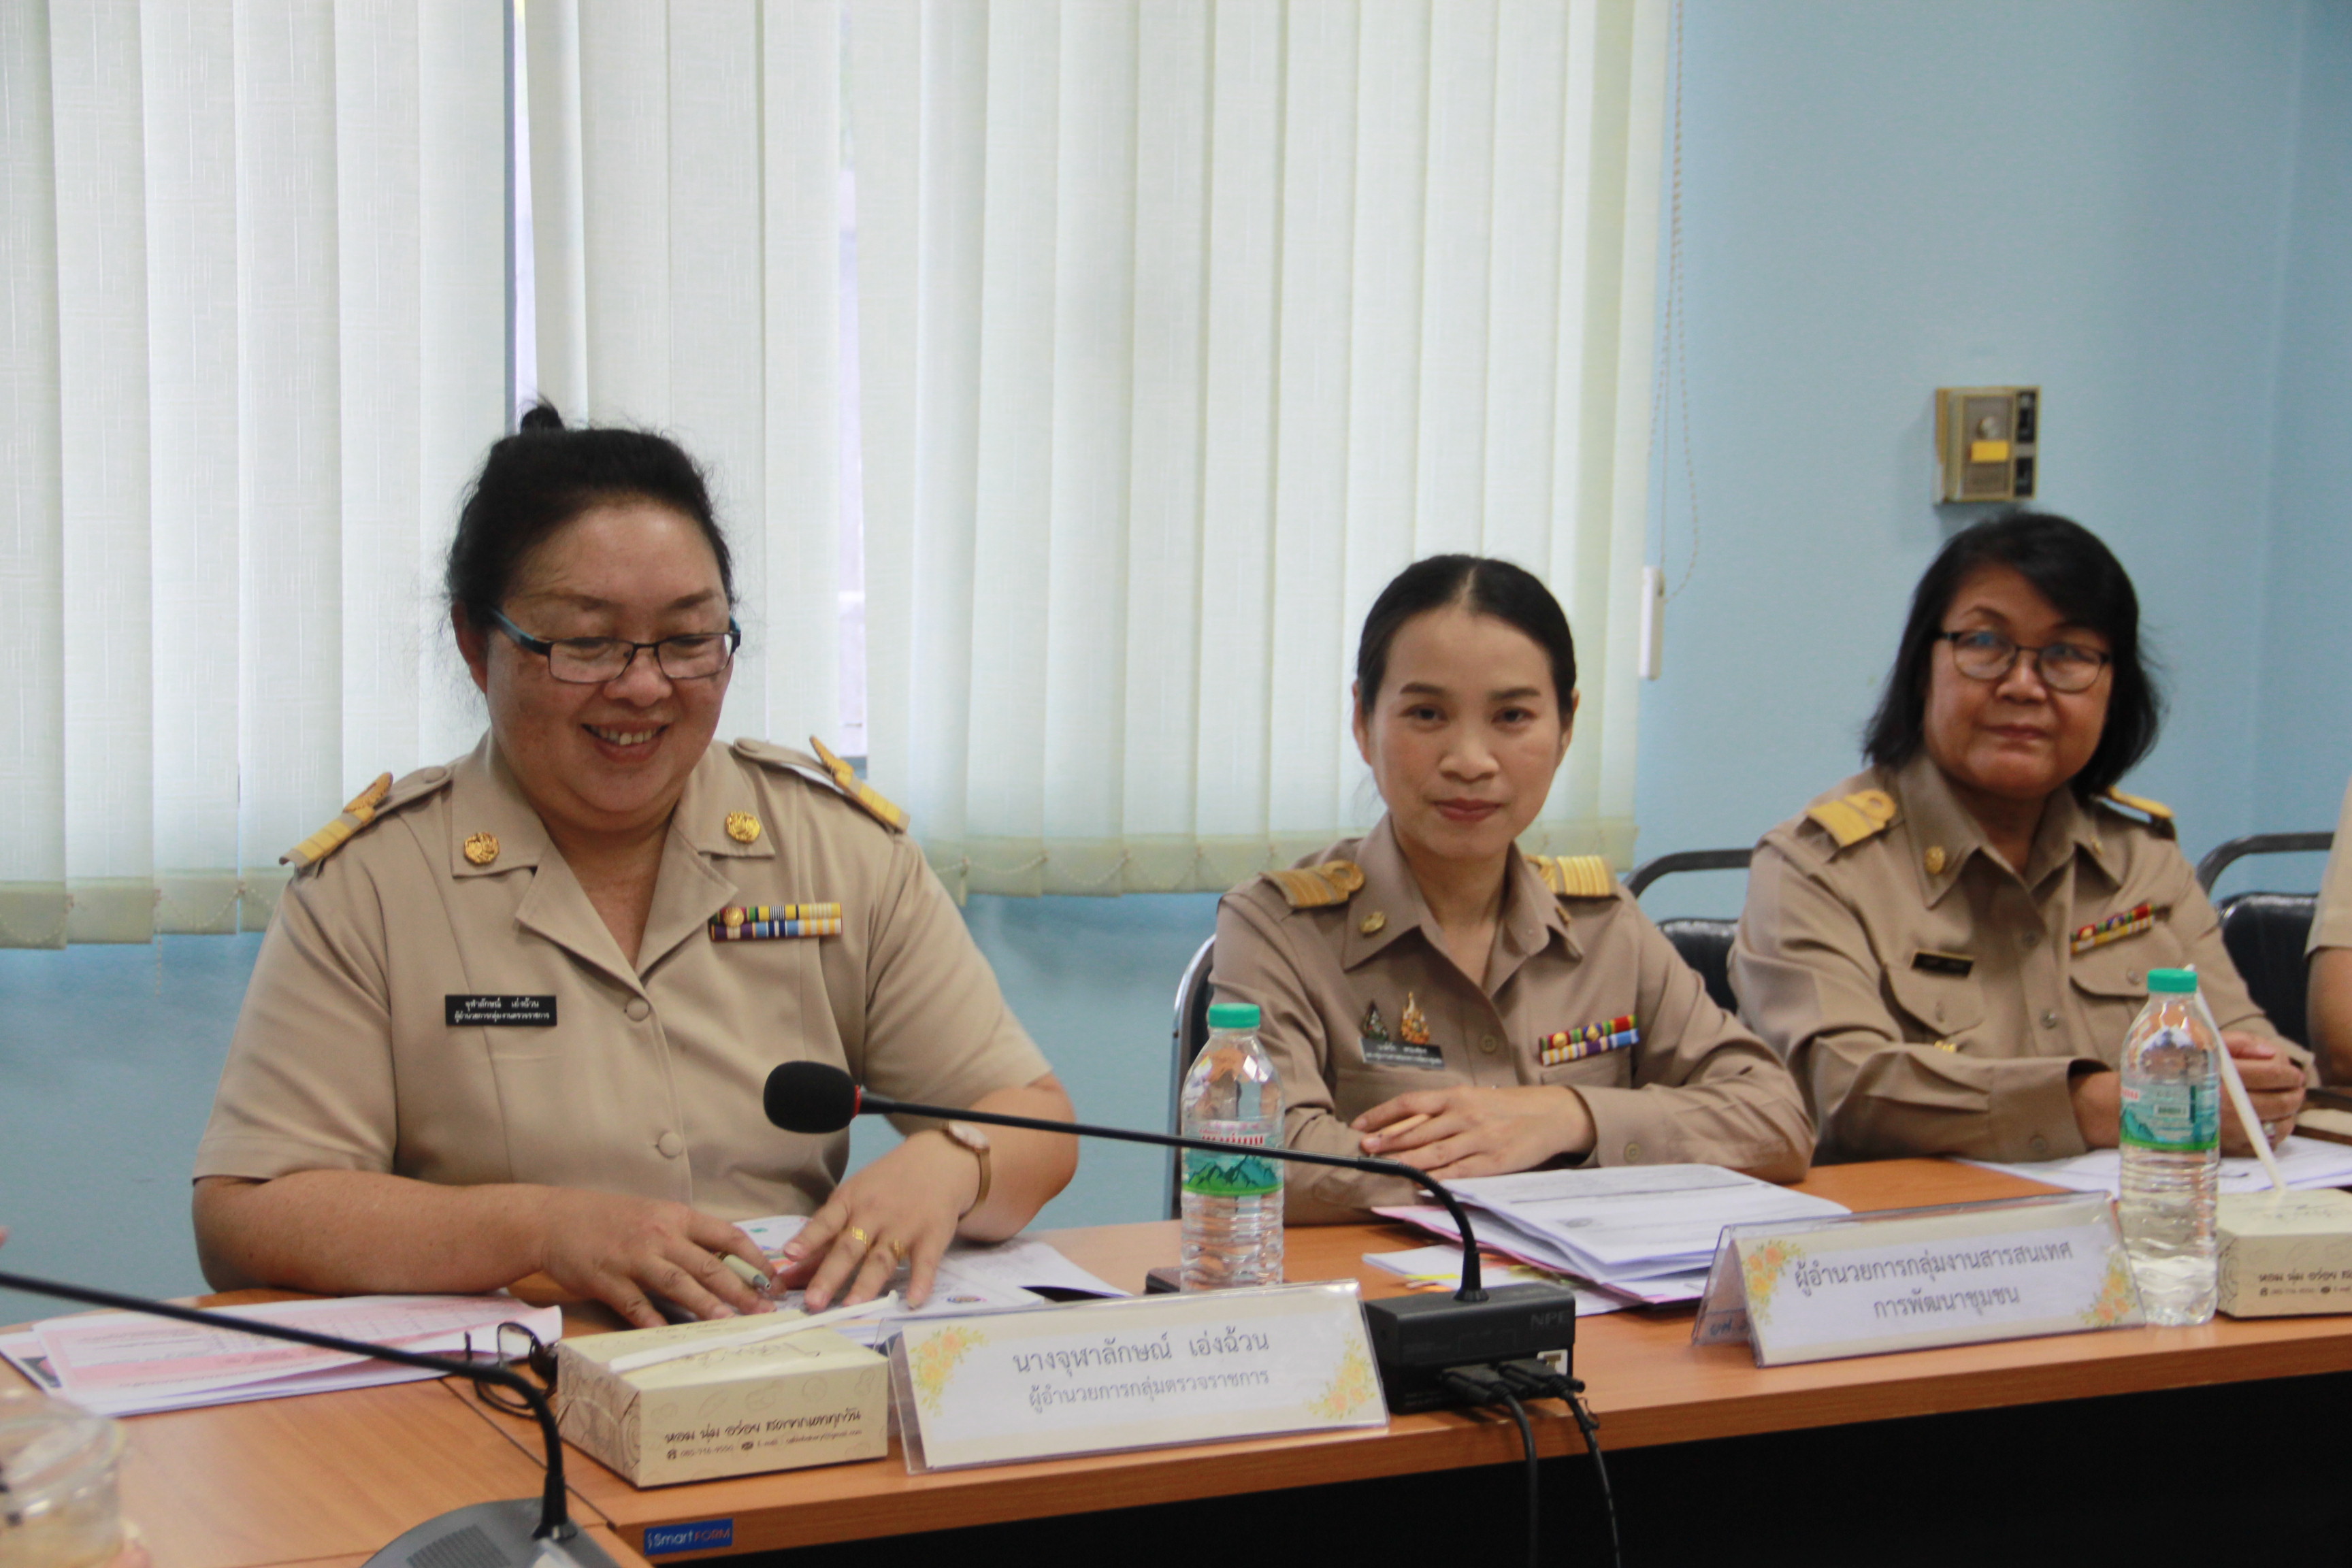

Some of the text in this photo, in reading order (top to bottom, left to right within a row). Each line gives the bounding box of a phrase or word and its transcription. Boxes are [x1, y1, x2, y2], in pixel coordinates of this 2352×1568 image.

[1795, 1240, 2074, 1297] ผู้อำนวยการกลุ่มงานสารสนเทศ
[1874, 1286, 2020, 1318] การพัฒนาชุมชน
[1012, 1325, 1270, 1377] นางจุฬาลักษณ์ เอ่งฉ้วน
[1028, 1369, 1270, 1414] ผู้อำนวยการกลุ่มตรวจราชการ
[724, 1418, 761, 1436] อร่อย
